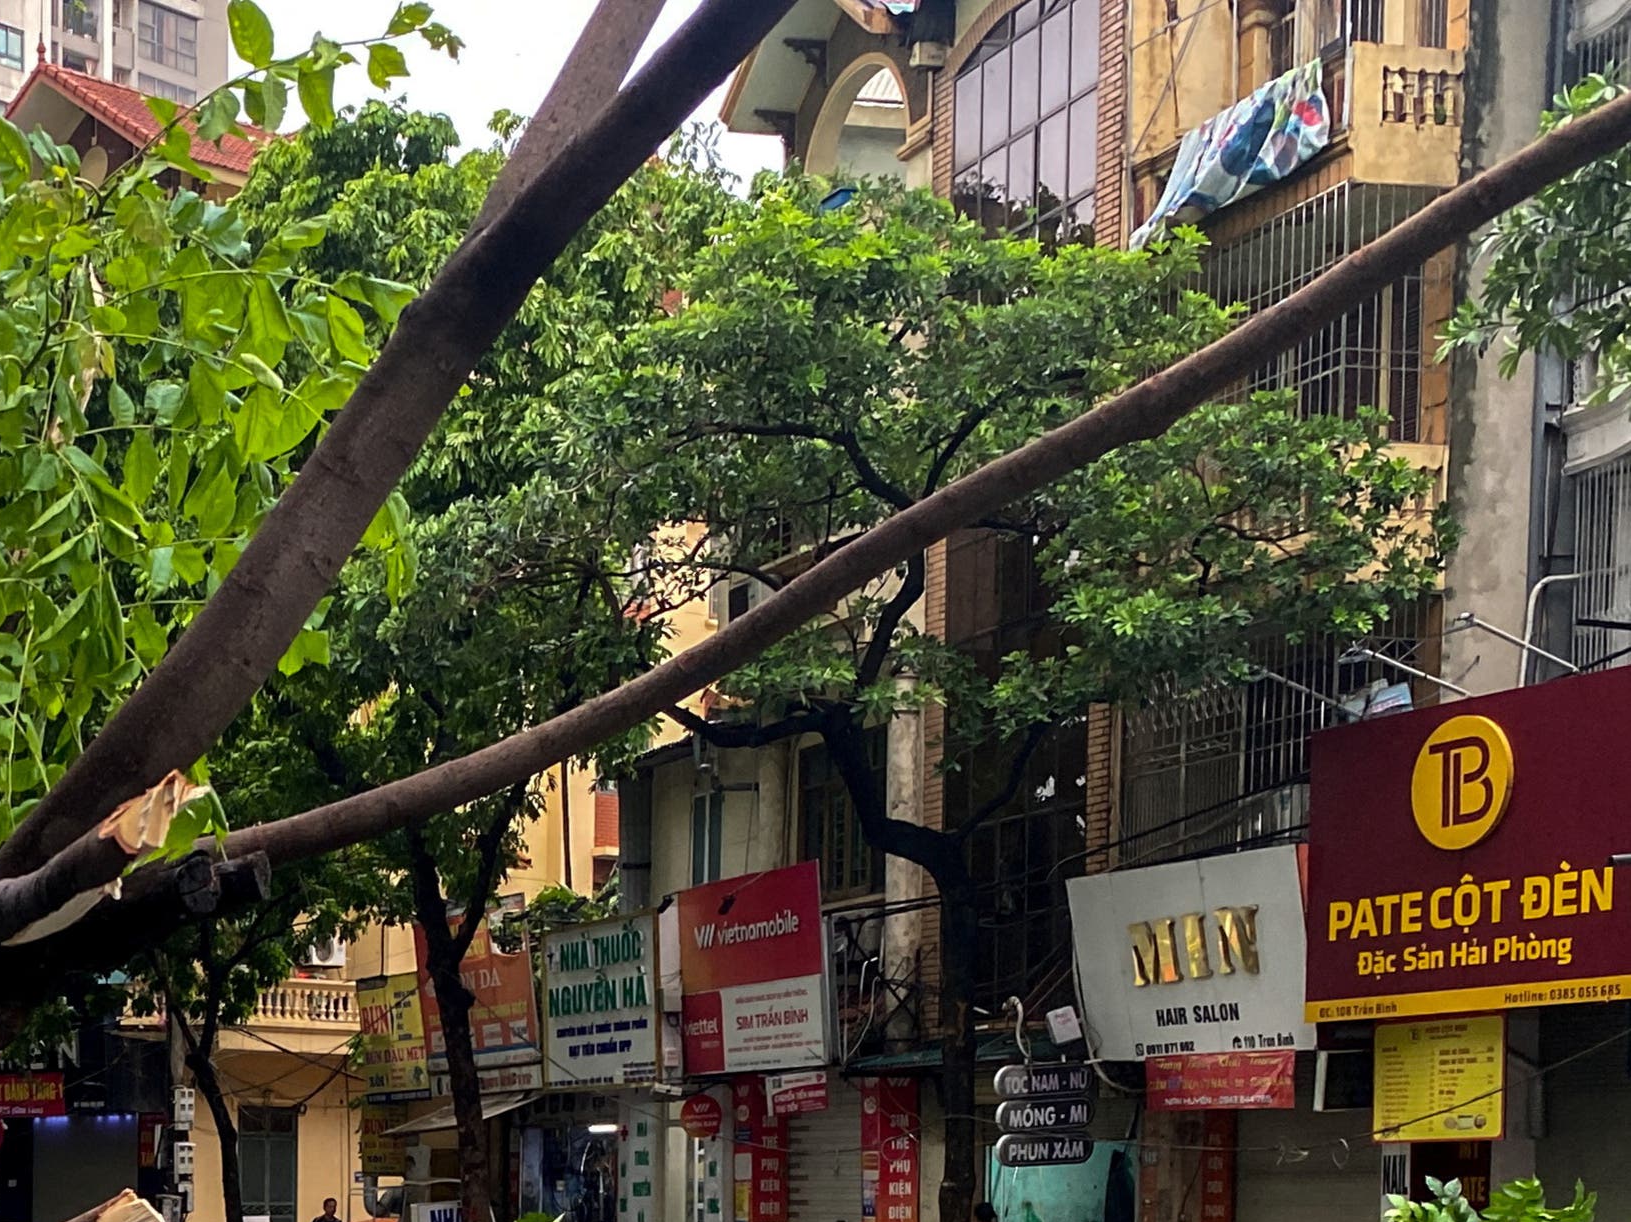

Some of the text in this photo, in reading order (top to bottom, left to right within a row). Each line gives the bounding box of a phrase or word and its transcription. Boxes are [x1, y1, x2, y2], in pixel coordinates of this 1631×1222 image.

[1328, 861, 1614, 942] PATE CỘT ĐÈN
[718, 909, 799, 945] vietnamobile
[560, 920, 643, 972] NHÀ THUỐC
[1127, 904, 1260, 987] MIN
[1357, 932, 1573, 980] Đặc Sản Hải Phòng
[1504, 991, 1547, 1004] Hotline:
[684, 1016, 719, 1035] viettel
[736, 1013, 754, 1030] SIM
[1156, 1003, 1240, 1027] HAIR SALON
[1031, 1074, 1060, 1093] NAM
[1009, 1104, 1056, 1128] MÓNG
[1069, 1104, 1088, 1123] MI
[1009, 1142, 1049, 1161] PHUN
[889, 1159, 911, 1177] PHỤ
[1382, 1154, 1408, 1195] NAIL
[888, 1179, 912, 1199] KIỆN
